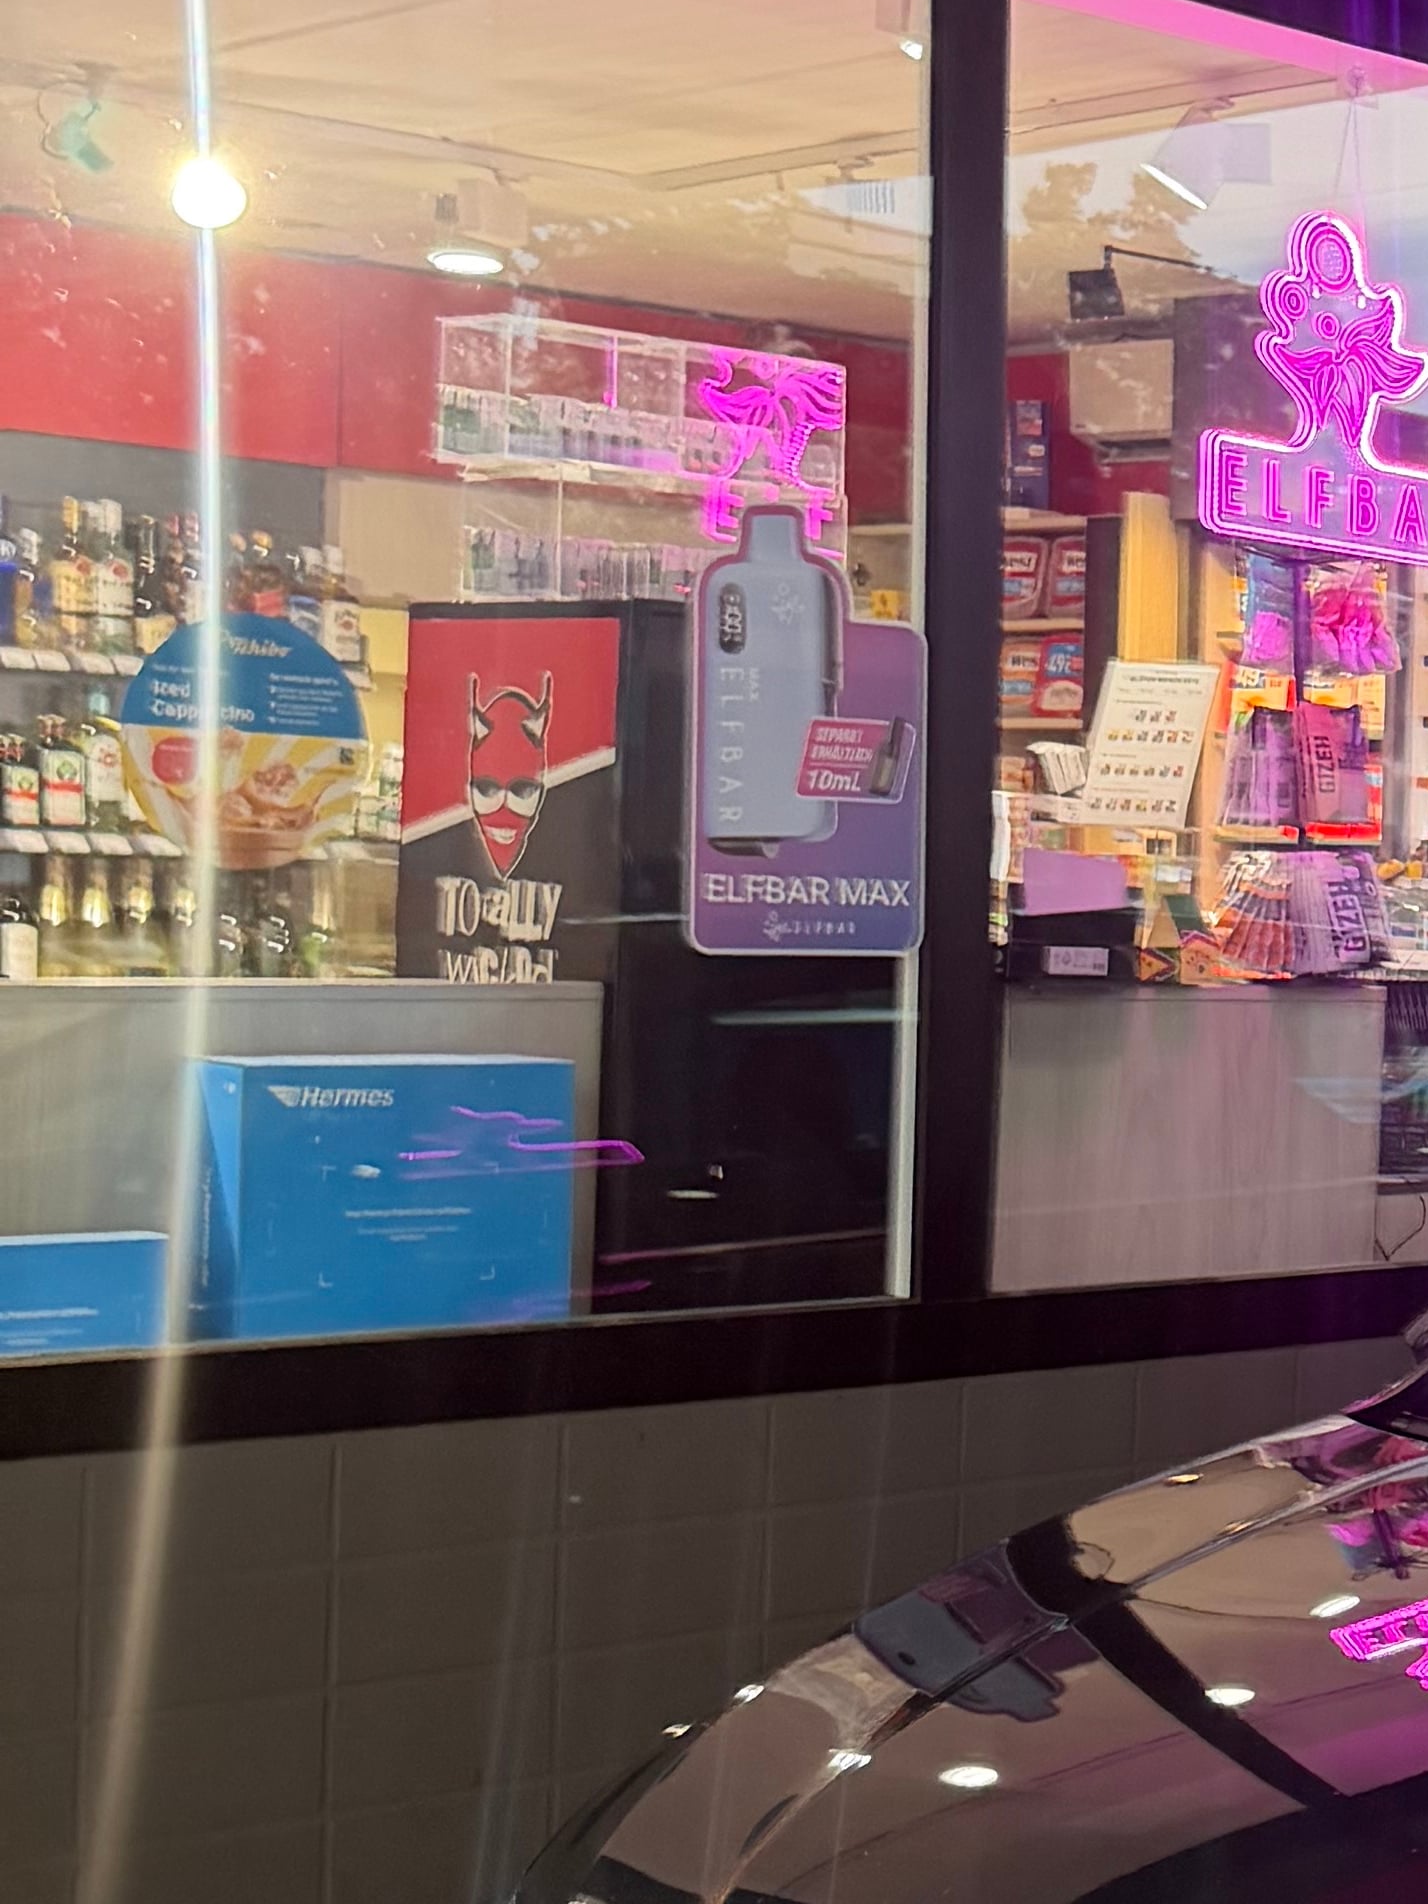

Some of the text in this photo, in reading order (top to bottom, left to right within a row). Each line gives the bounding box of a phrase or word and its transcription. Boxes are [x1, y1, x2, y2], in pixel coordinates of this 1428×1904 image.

[151, 679, 191, 698] Iced
[150, 698, 256, 723] Cappcino
[718, 666, 746, 823] ELFBAR
[702, 873, 911, 908] ELFBAR MAX
[300, 1085, 395, 1107] Hermes
